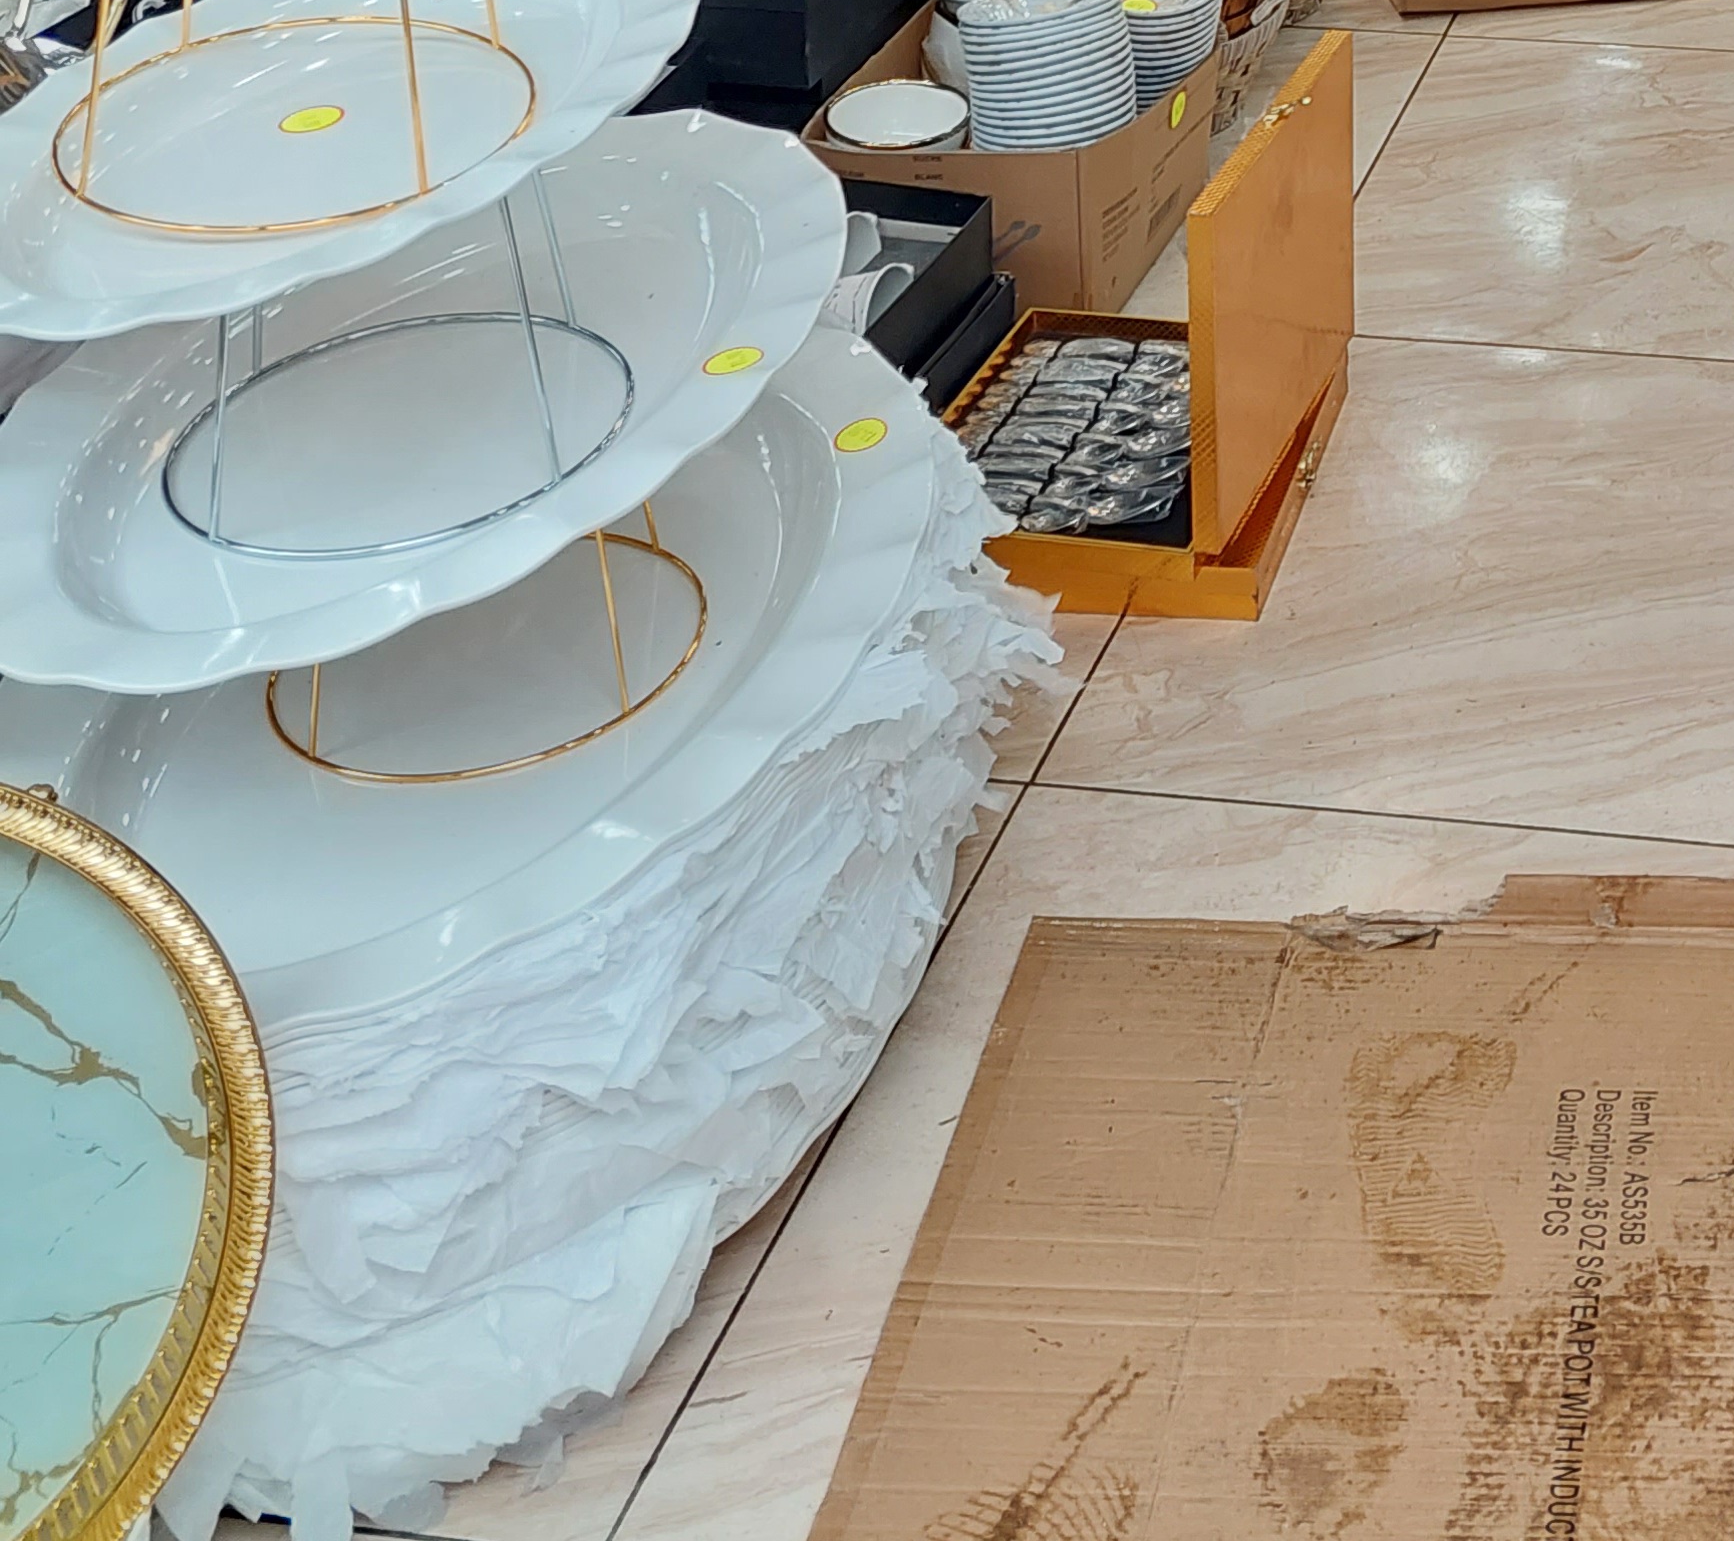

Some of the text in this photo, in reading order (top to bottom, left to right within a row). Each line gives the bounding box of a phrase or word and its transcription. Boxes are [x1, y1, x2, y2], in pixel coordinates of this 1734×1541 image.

[1546, 1089, 1586, 1167] Quantity:
[1584, 1089, 1622, 1193] Description:
[1618, 1089, 1659, 1246] Item No.: AS535B
[1578, 1224, 1608, 1251] OZ
[1581, 1197, 1610, 1220] 35
[1555, 1391, 1591, 1453] WITH
[1545, 1459, 1583, 1541] INDUC
